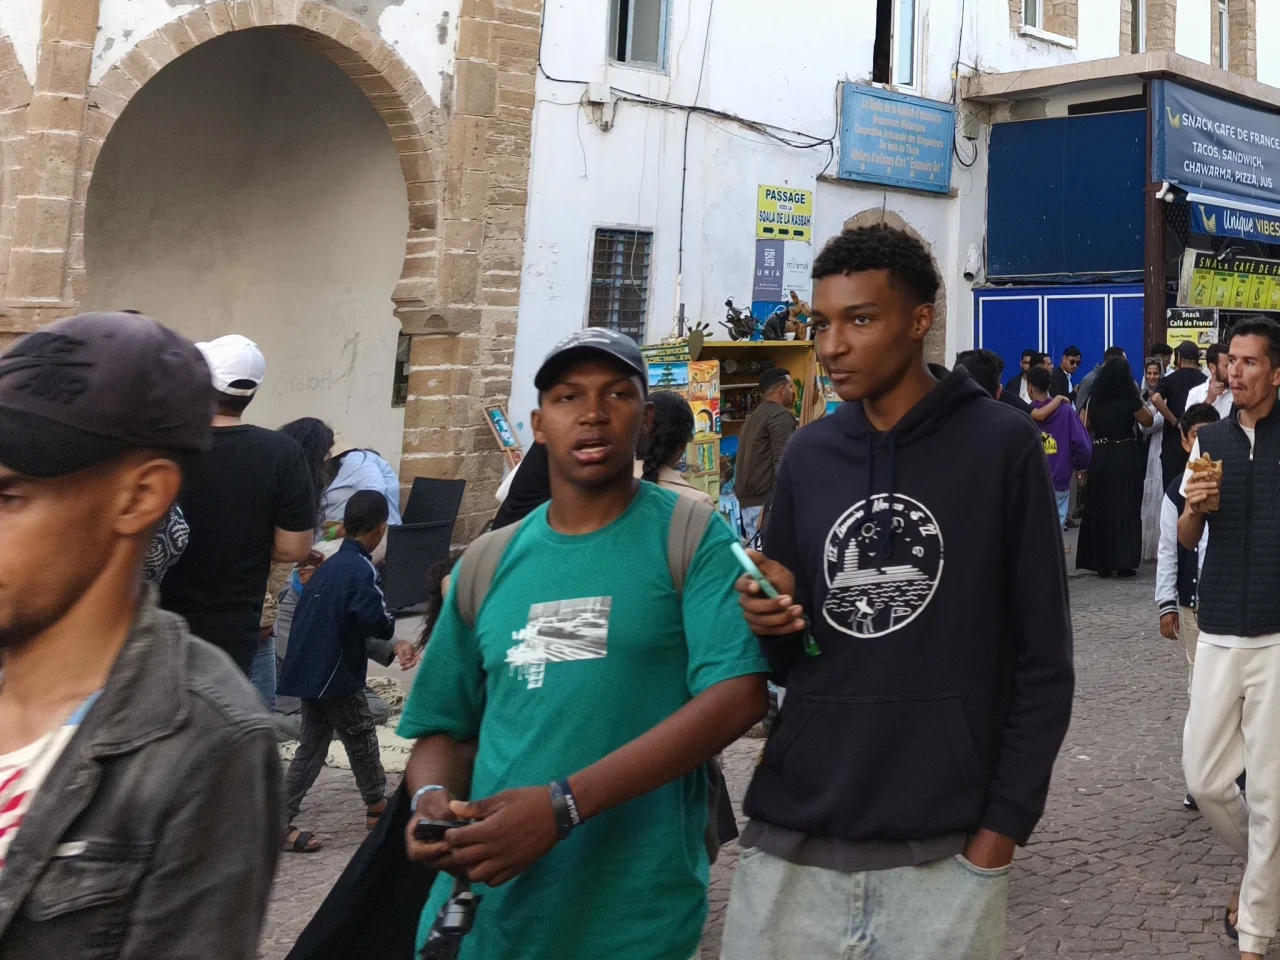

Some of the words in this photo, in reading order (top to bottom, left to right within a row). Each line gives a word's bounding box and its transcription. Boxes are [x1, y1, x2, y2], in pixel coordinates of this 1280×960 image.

[1182, 113, 1213, 132] SNACK
[1214, 122, 1236, 138] CAFE
[1238, 128, 1248, 141] DE
[1250, 132, 1280, 150] FRANCE
[1192, 142, 1221, 160] TACOS,
[1222, 149, 1264, 170] SANDWICH,
[1184, 161, 1233, 182] CHAWARMA,
[1235, 171, 1259, 187] PIZZA,
[1260, 176, 1273, 188] JUS
[766, 189, 806, 204] PASSAGE
[759, 211, 776, 222] SQALA
[777, 212, 783, 224] DE
[784, 214, 790, 225] LA
[1224, 210, 1253, 238] Unique
[1256, 218, 1280, 236] VIBES
[1234, 261, 1255, 273] CAFÉ
[1259, 264, 1269, 274] DE
[1182, 310, 1200, 318] Snack
